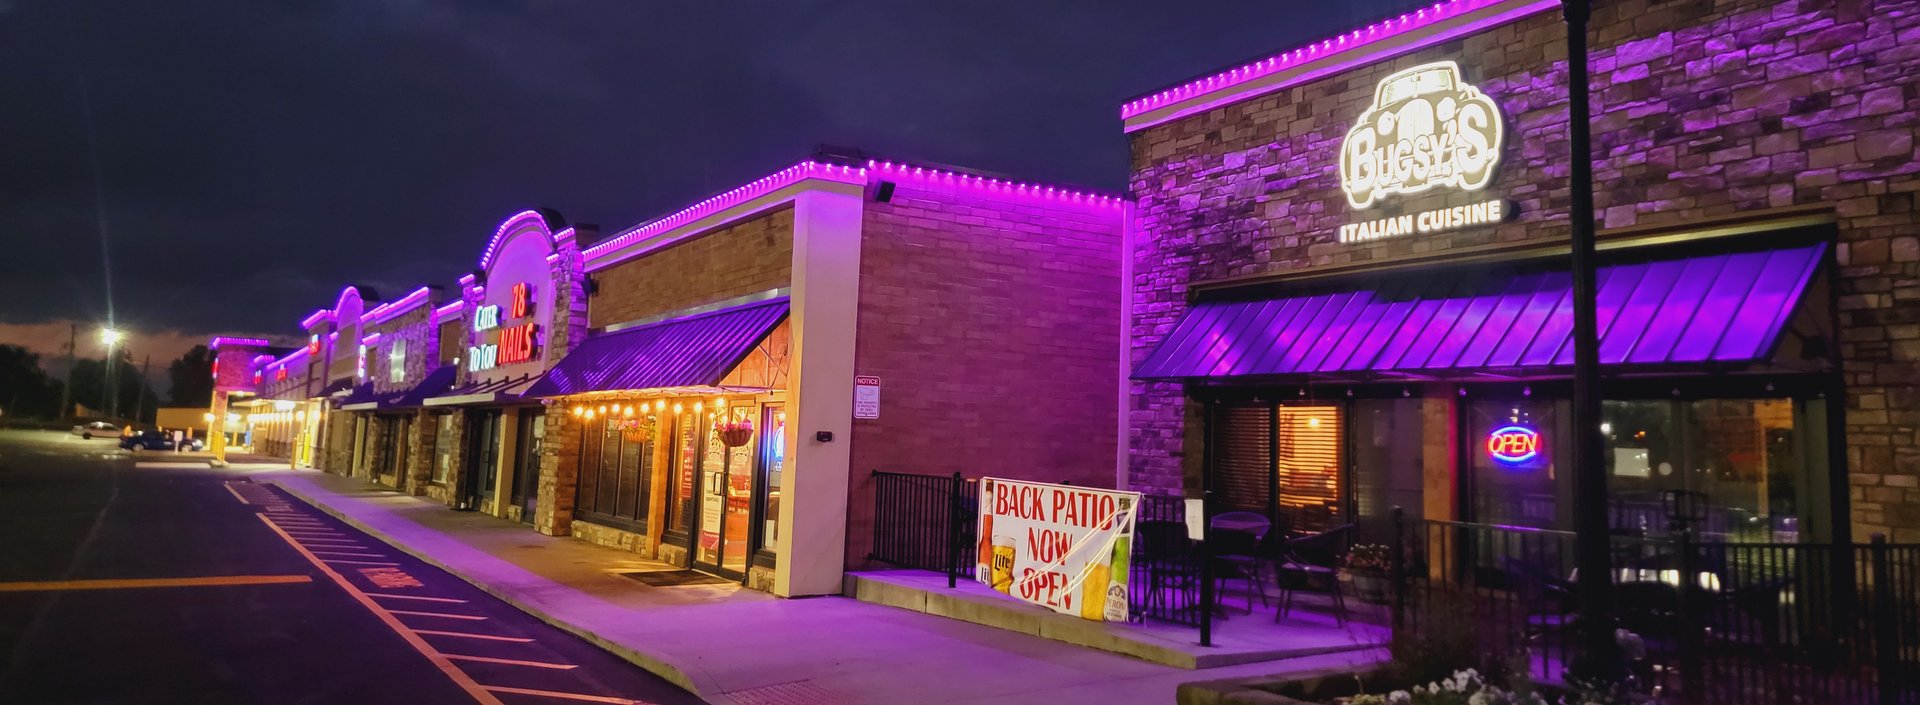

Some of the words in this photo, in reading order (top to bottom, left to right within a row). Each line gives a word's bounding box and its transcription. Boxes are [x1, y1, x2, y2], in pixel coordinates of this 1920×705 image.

[1350, 103, 1488, 193] BUGSY'S
[1340, 214, 1413, 243] ITALIAN
[1417, 200, 1501, 232] CUISINE
[475, 304, 498, 332] CATER
[512, 281, 527, 319] 78
[480, 343, 498, 370] YOU
[498, 322, 534, 364] NAILS
[1488, 433, 1538, 453] OPEN
[995, 483, 1045, 522] BACK
[1052, 489, 1115, 531] PATIO
[994, 553, 1011, 571] Lite
[1026, 526, 1073, 566] NOW
[1019, 567, 1075, 610] OPEN
